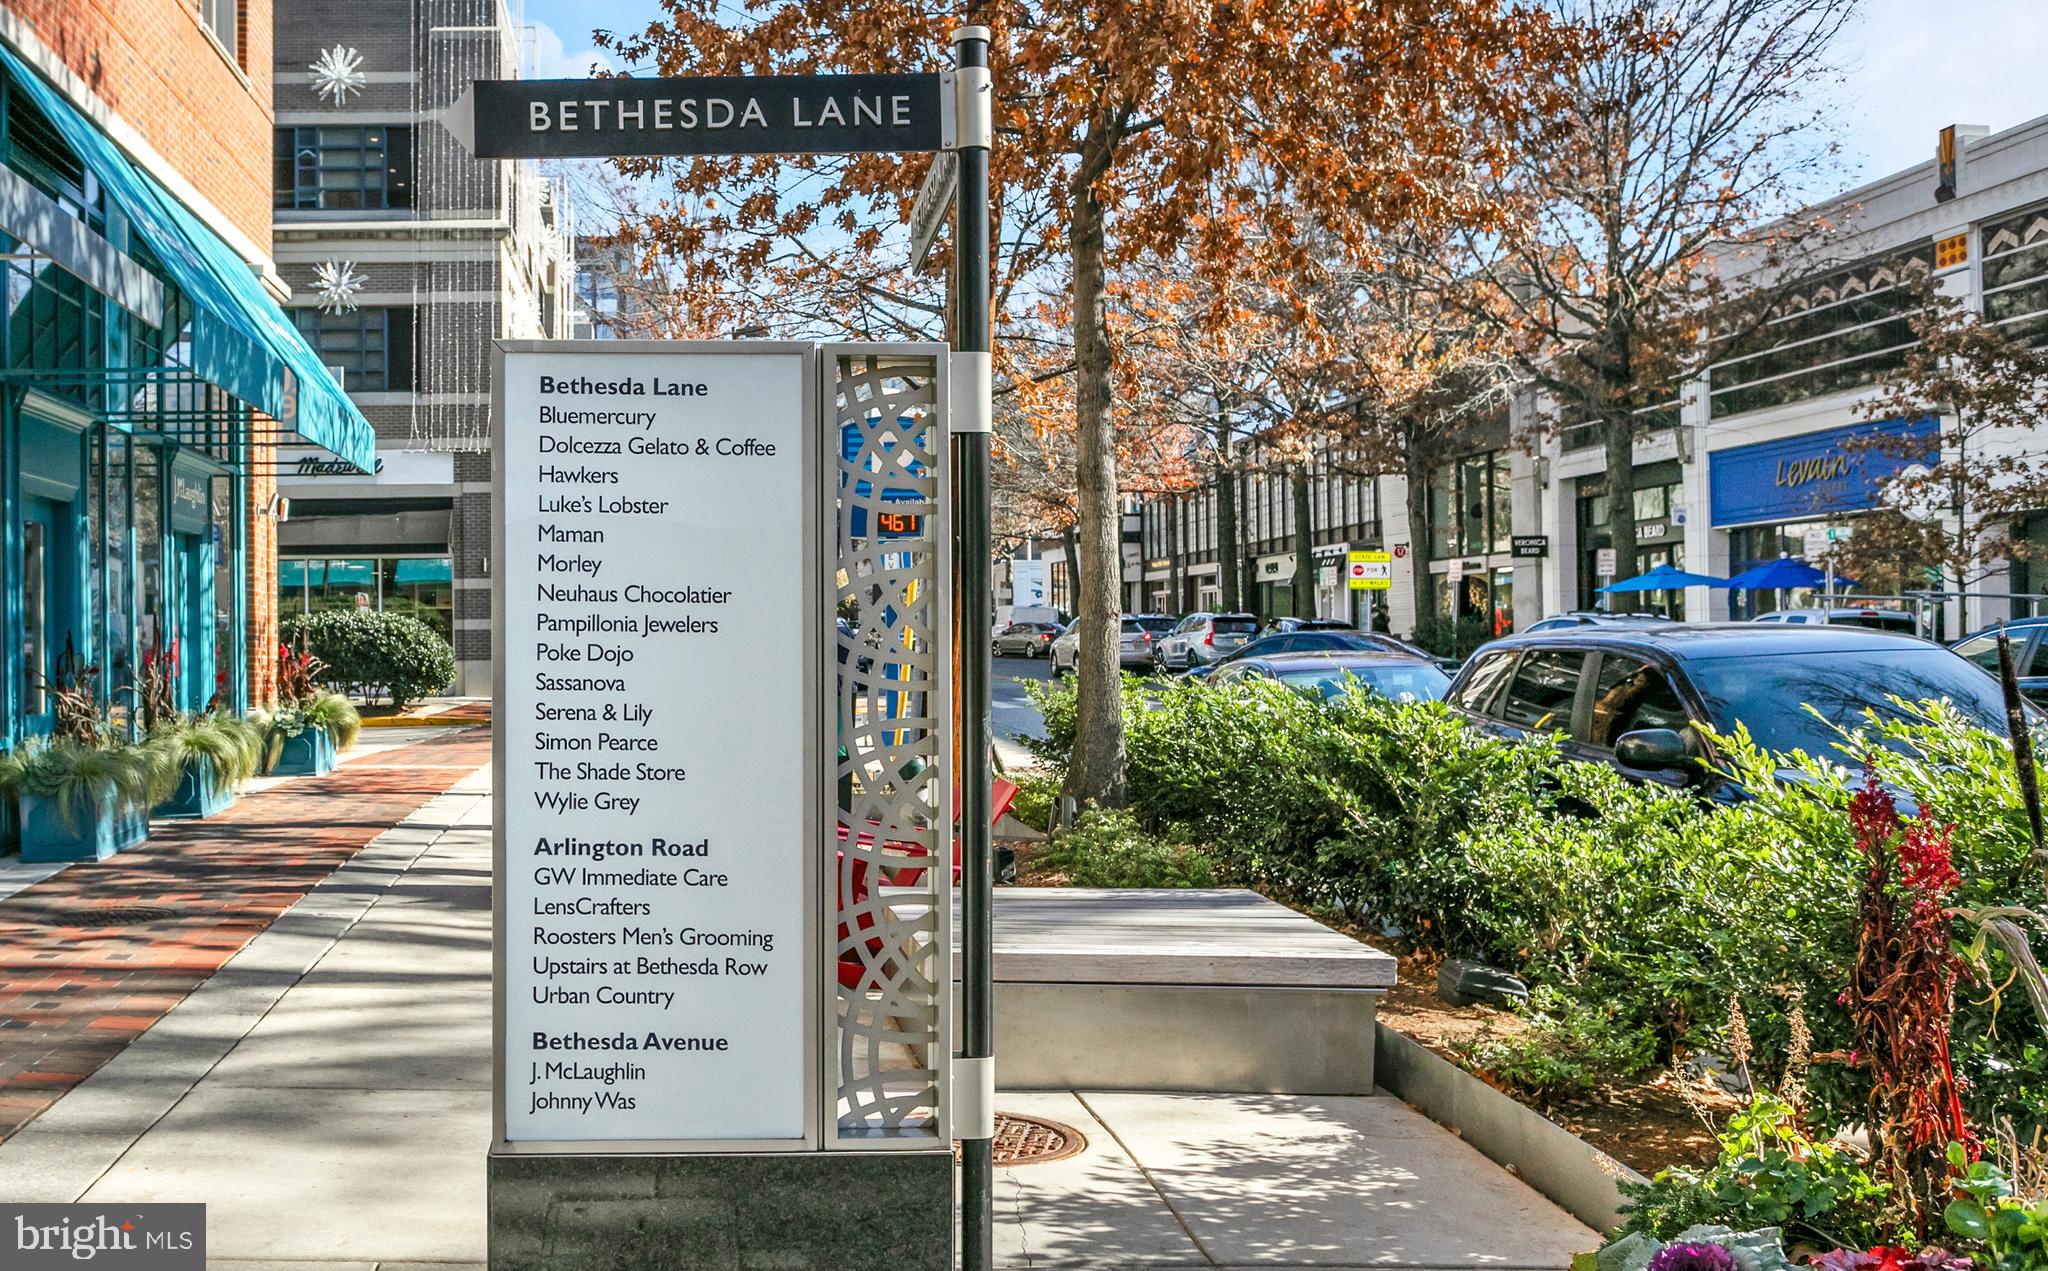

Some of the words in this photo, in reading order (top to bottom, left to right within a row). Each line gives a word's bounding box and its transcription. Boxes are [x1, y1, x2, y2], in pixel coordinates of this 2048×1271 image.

[530, 97, 768, 132] BETHESDA
[793, 95, 911, 127] LANE
[539, 375, 647, 396] Bethesda
[653, 377, 709, 397] Lane
[539, 405, 657, 431] Bluemercury
[539, 435, 623, 455] Dolcezza
[627, 436, 690, 456] Gelato
[694, 437, 710, 456] &
[715, 437, 777, 457] Coffee
[297, 456, 384, 476] Madewl
[538, 464, 619, 484] Hawkers
[1775, 449, 1851, 488] Levain
[538, 494, 593, 514] Luke’s
[598, 495, 670, 515] Lobster
[538, 524, 604, 543] Maman
[881, 513, 917, 532] 461
[1643, 524, 1666, 538] BEARD
[1514, 538, 1547, 546] VERONICA
[537, 553, 603, 579] Morley
[537, 583, 618, 603] Neuhaus
[623, 584, 733, 604] Chocolatier
[537, 613, 639, 638] Pampillonia
[641, 614, 719, 638] Jewelers
[536, 642, 582, 662] Poke
[587, 643, 634, 667] Dojo
[535, 672, 626, 692] Sassanova
[535, 702, 598, 721] Serena
[601, 703, 618, 722] &
[623, 703, 654, 727] Lily
[534, 731, 592, 751] Simon
[598, 732, 658, 752] Pearce
[534, 761, 572, 781] The
[576, 761, 631, 781] Shade
[635, 762, 686, 782] Store
[533, 791, 589, 816] Wylie
[593, 791, 641, 816] Grey
[533, 837, 643, 862] Arlington
[651, 837, 709, 857] Road
[533, 866, 577, 886] GW
[582, 867, 678, 887] Immediate
[683, 868, 729, 887] Care
[534, 896, 651, 916] LensCrafters
[533, 926, 617, 945] Roosters
[622, 926, 674, 946] Men’s
[679, 927, 775, 952] Grooming
[533, 956, 608, 980] Upstairs
[613, 960, 632, 975] at
[636, 956, 720, 976] Bethesda
[725, 957, 769, 976] Row
[532, 985, 590, 1005] Urban
[596, 985, 675, 1011] Country
[532, 1031, 639, 1051] Bethesda
[642, 1032, 729, 1052] Avenue
[529, 1061, 542, 1086] J.
[545, 1061, 646, 1086] McLaughlin
[528, 1091, 593, 1115] Johnny
[593, 1091, 637, 1110] Was
